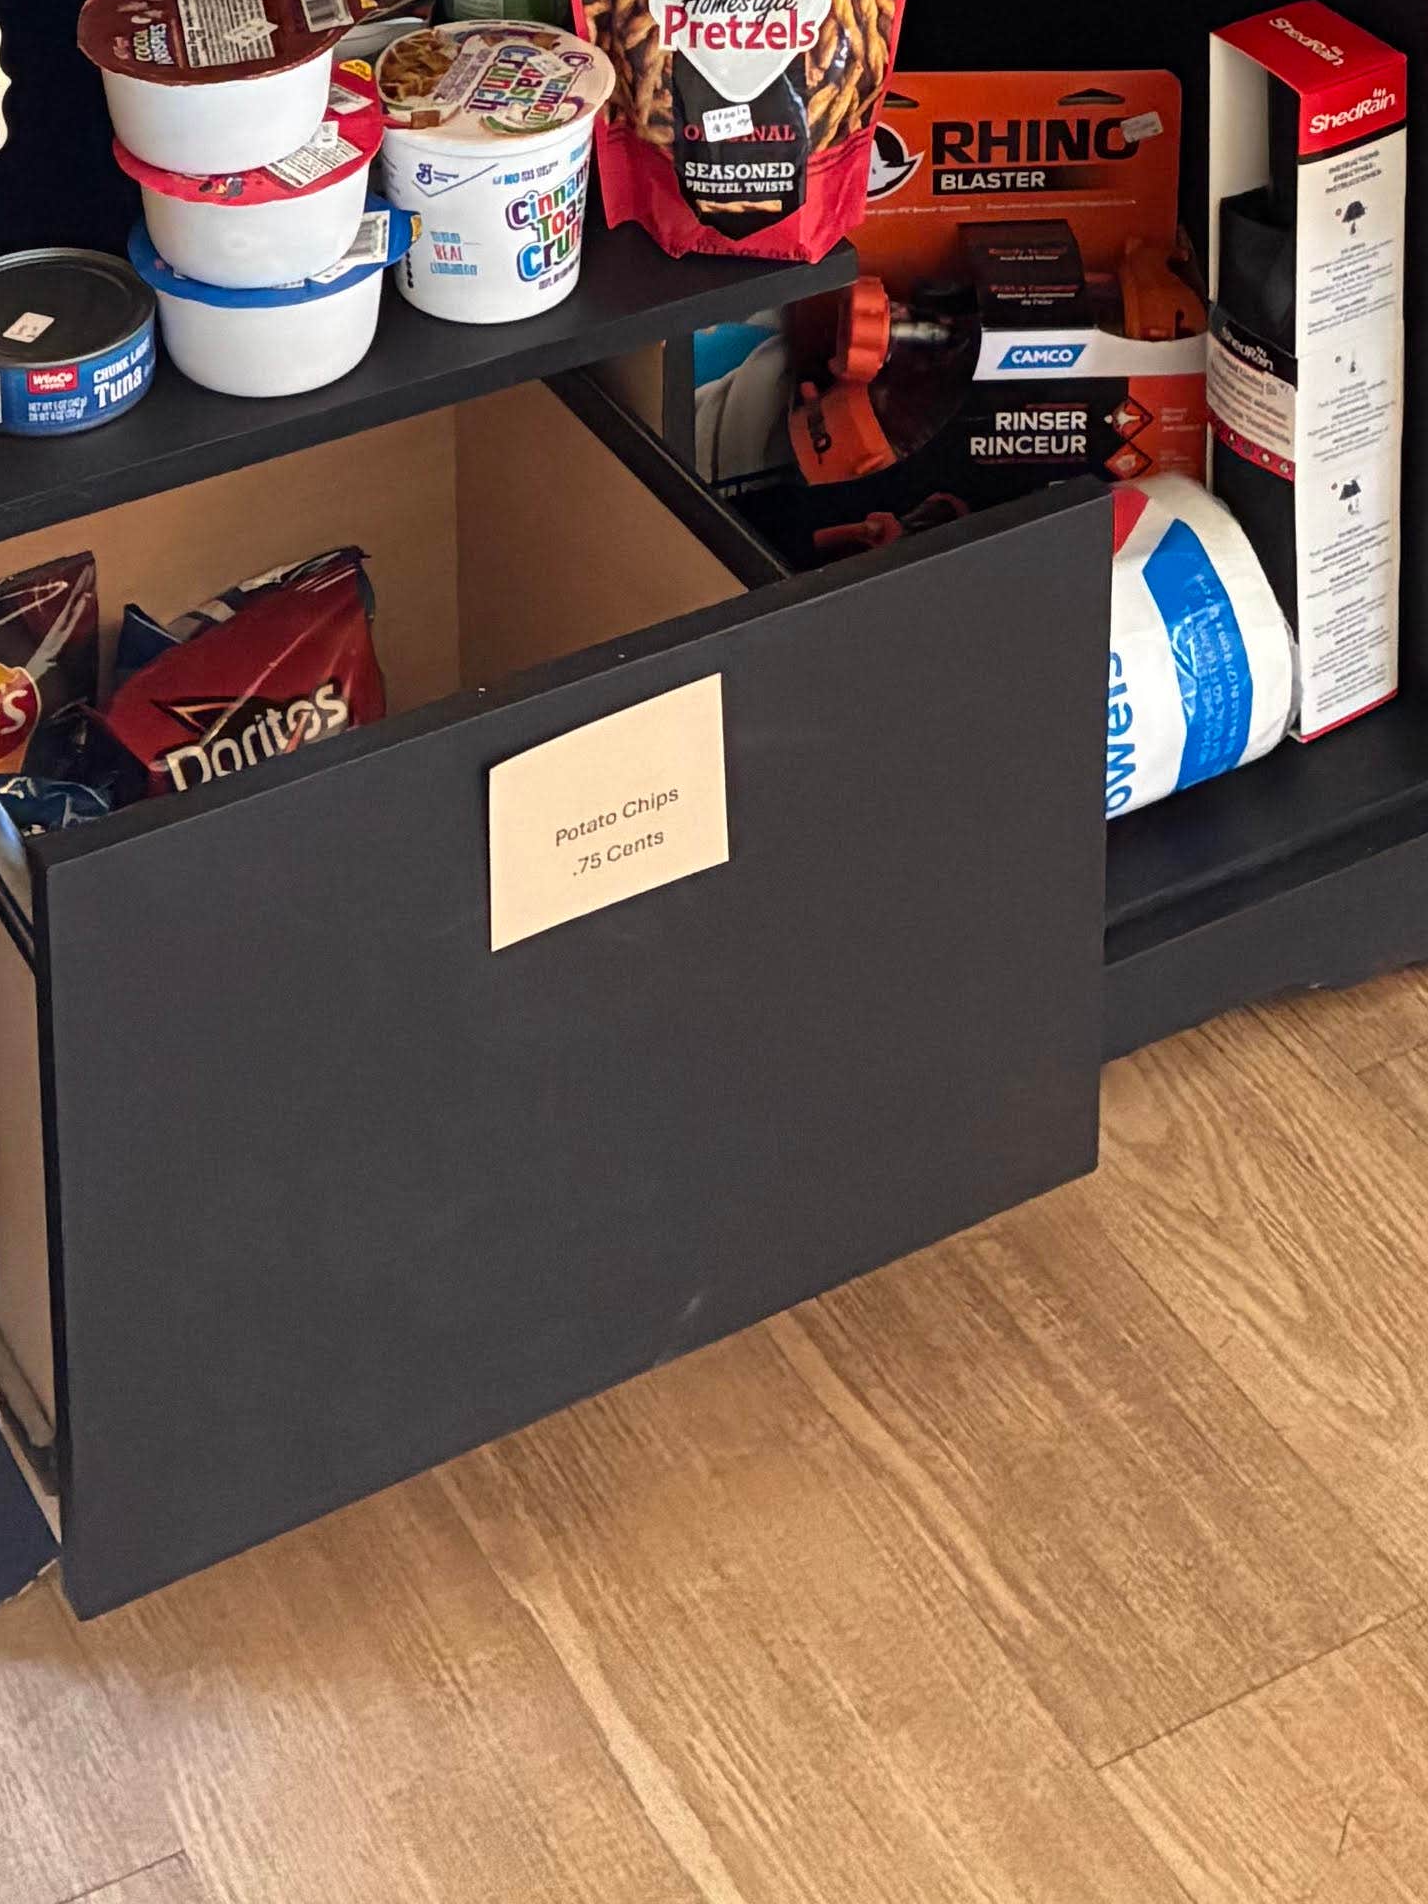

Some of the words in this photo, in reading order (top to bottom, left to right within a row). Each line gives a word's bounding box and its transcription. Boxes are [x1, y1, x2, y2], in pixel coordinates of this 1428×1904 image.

[663, 4, 817, 51] Pretzels
[1309, 92, 1397, 136] ShedRain
[931, 116, 1144, 166] RHINO
[684, 161, 796, 180] SEASONED
[685, 180, 743, 194] PRETZEL
[744, 180, 795, 193] TWISTS
[940, 171, 1047, 192] BLASTER
[509, 159, 589, 227] Cinnam
[520, 220, 582, 280] Crun
[32, 372, 74, 386] WinCo
[93, 353, 130, 385] CHUNK
[1010, 349, 1075, 365] CAMCO
[93, 365, 143, 410] Tuna
[995, 410, 1088, 432] RINSER
[969, 435, 1088, 456] RINCEUR
[165, 683, 349, 793] Doritos
[556, 811, 618, 847] Potato
[621, 784, 681, 820] Chips
[572, 852, 603, 878] .75
[606, 828, 666, 865] Cents
